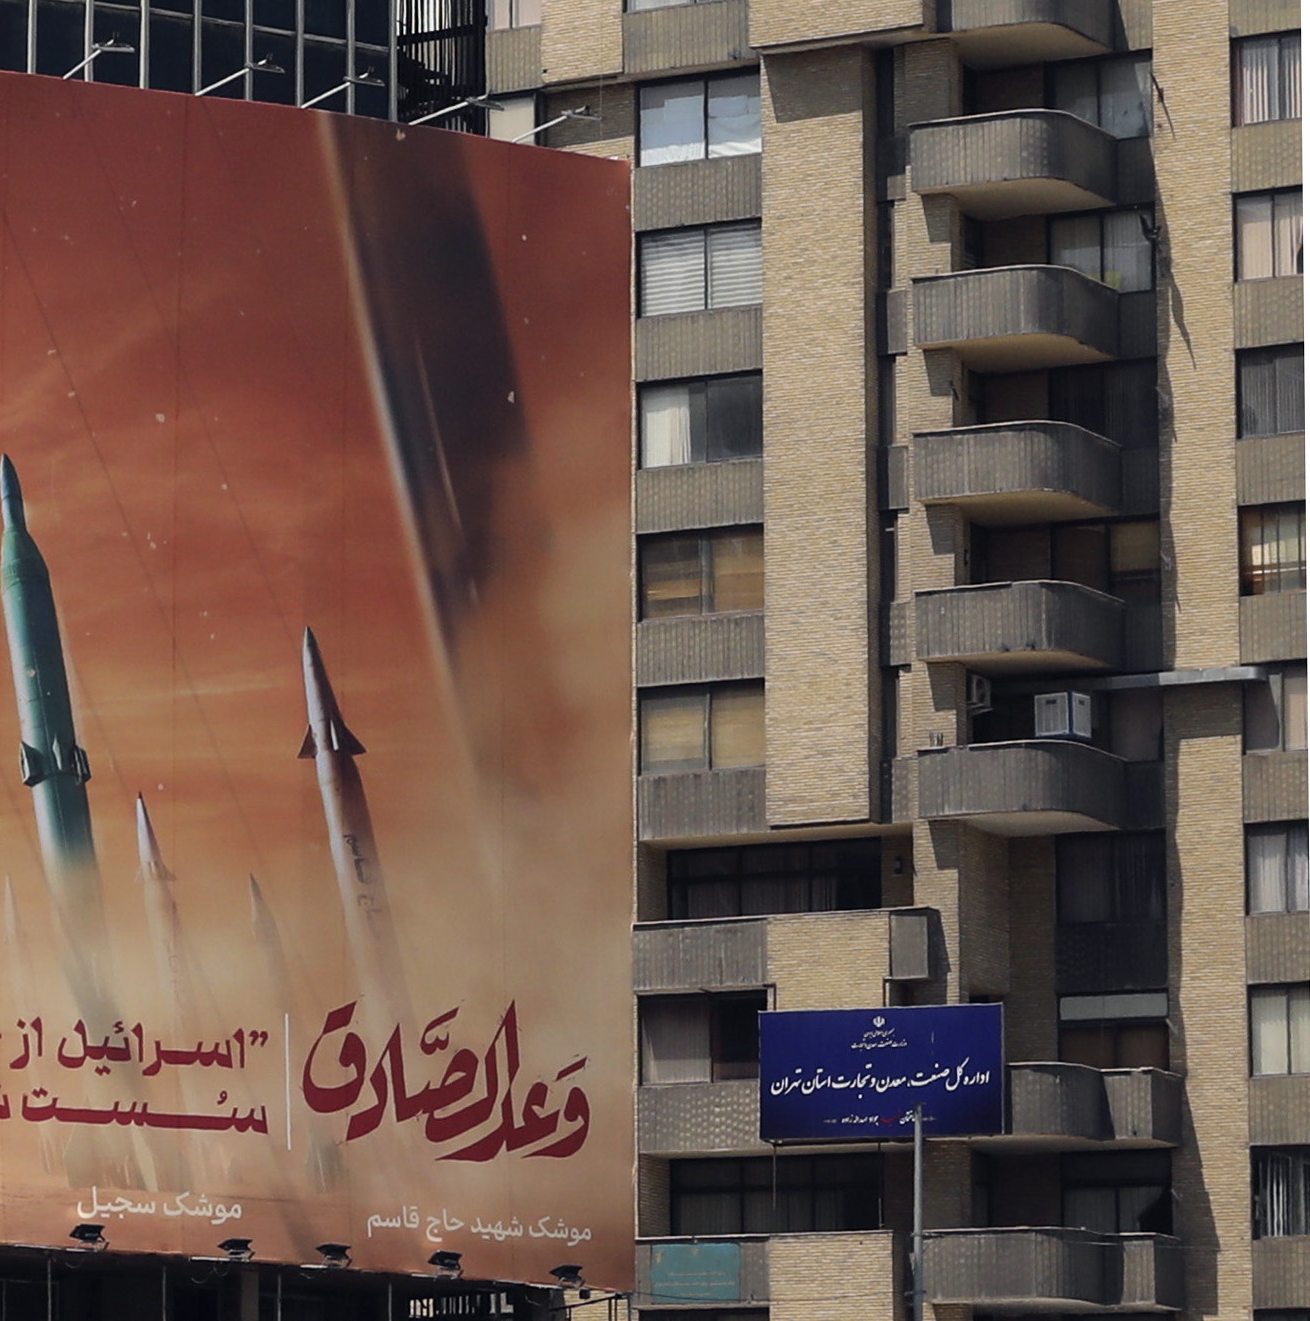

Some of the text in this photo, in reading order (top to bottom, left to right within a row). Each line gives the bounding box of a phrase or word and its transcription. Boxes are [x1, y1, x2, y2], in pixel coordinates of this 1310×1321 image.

[9, 1017, 43, 1069] از
[770, 1068, 802, 1096] تهران
[801, 1068, 832, 1095] استان
[831, 1063, 873, 1100] تجارت
[875, 1076, 907, 1094] معدن
[945, 1056, 970, 1092] کل
[963, 1070, 990, 1086] اداره
[77, 1186, 243, 1226] موشک سجیل
[366, 1205, 592, 1247] موشک شهید حاج قاسم
